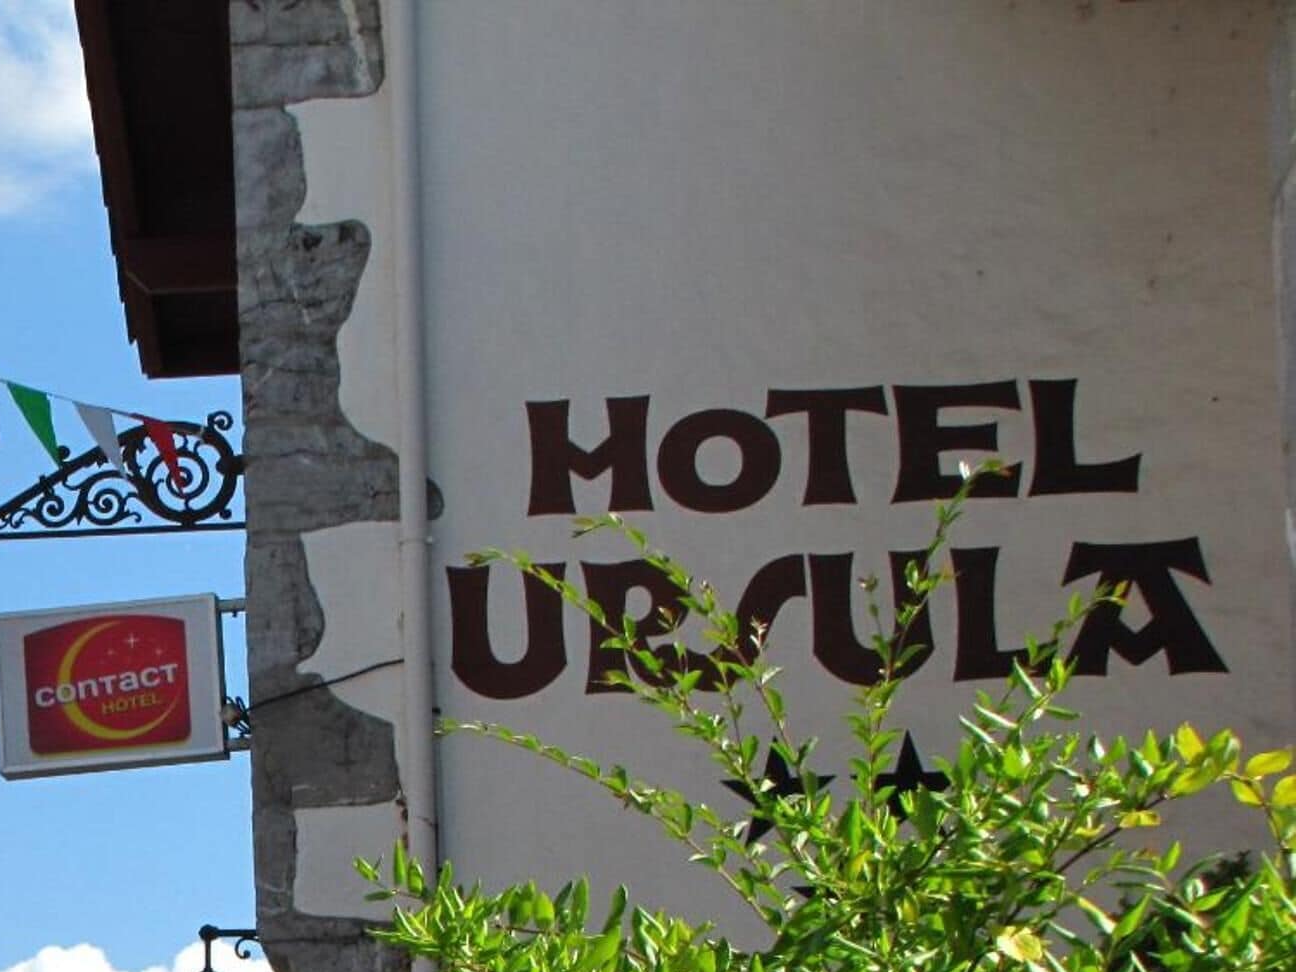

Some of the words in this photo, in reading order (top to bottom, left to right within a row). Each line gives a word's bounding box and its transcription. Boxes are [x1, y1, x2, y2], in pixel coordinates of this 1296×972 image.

[525, 378, 1143, 517] HOTEL
[445, 536, 1231, 701] URSULA
[101, 692, 161, 715] HOTEL
